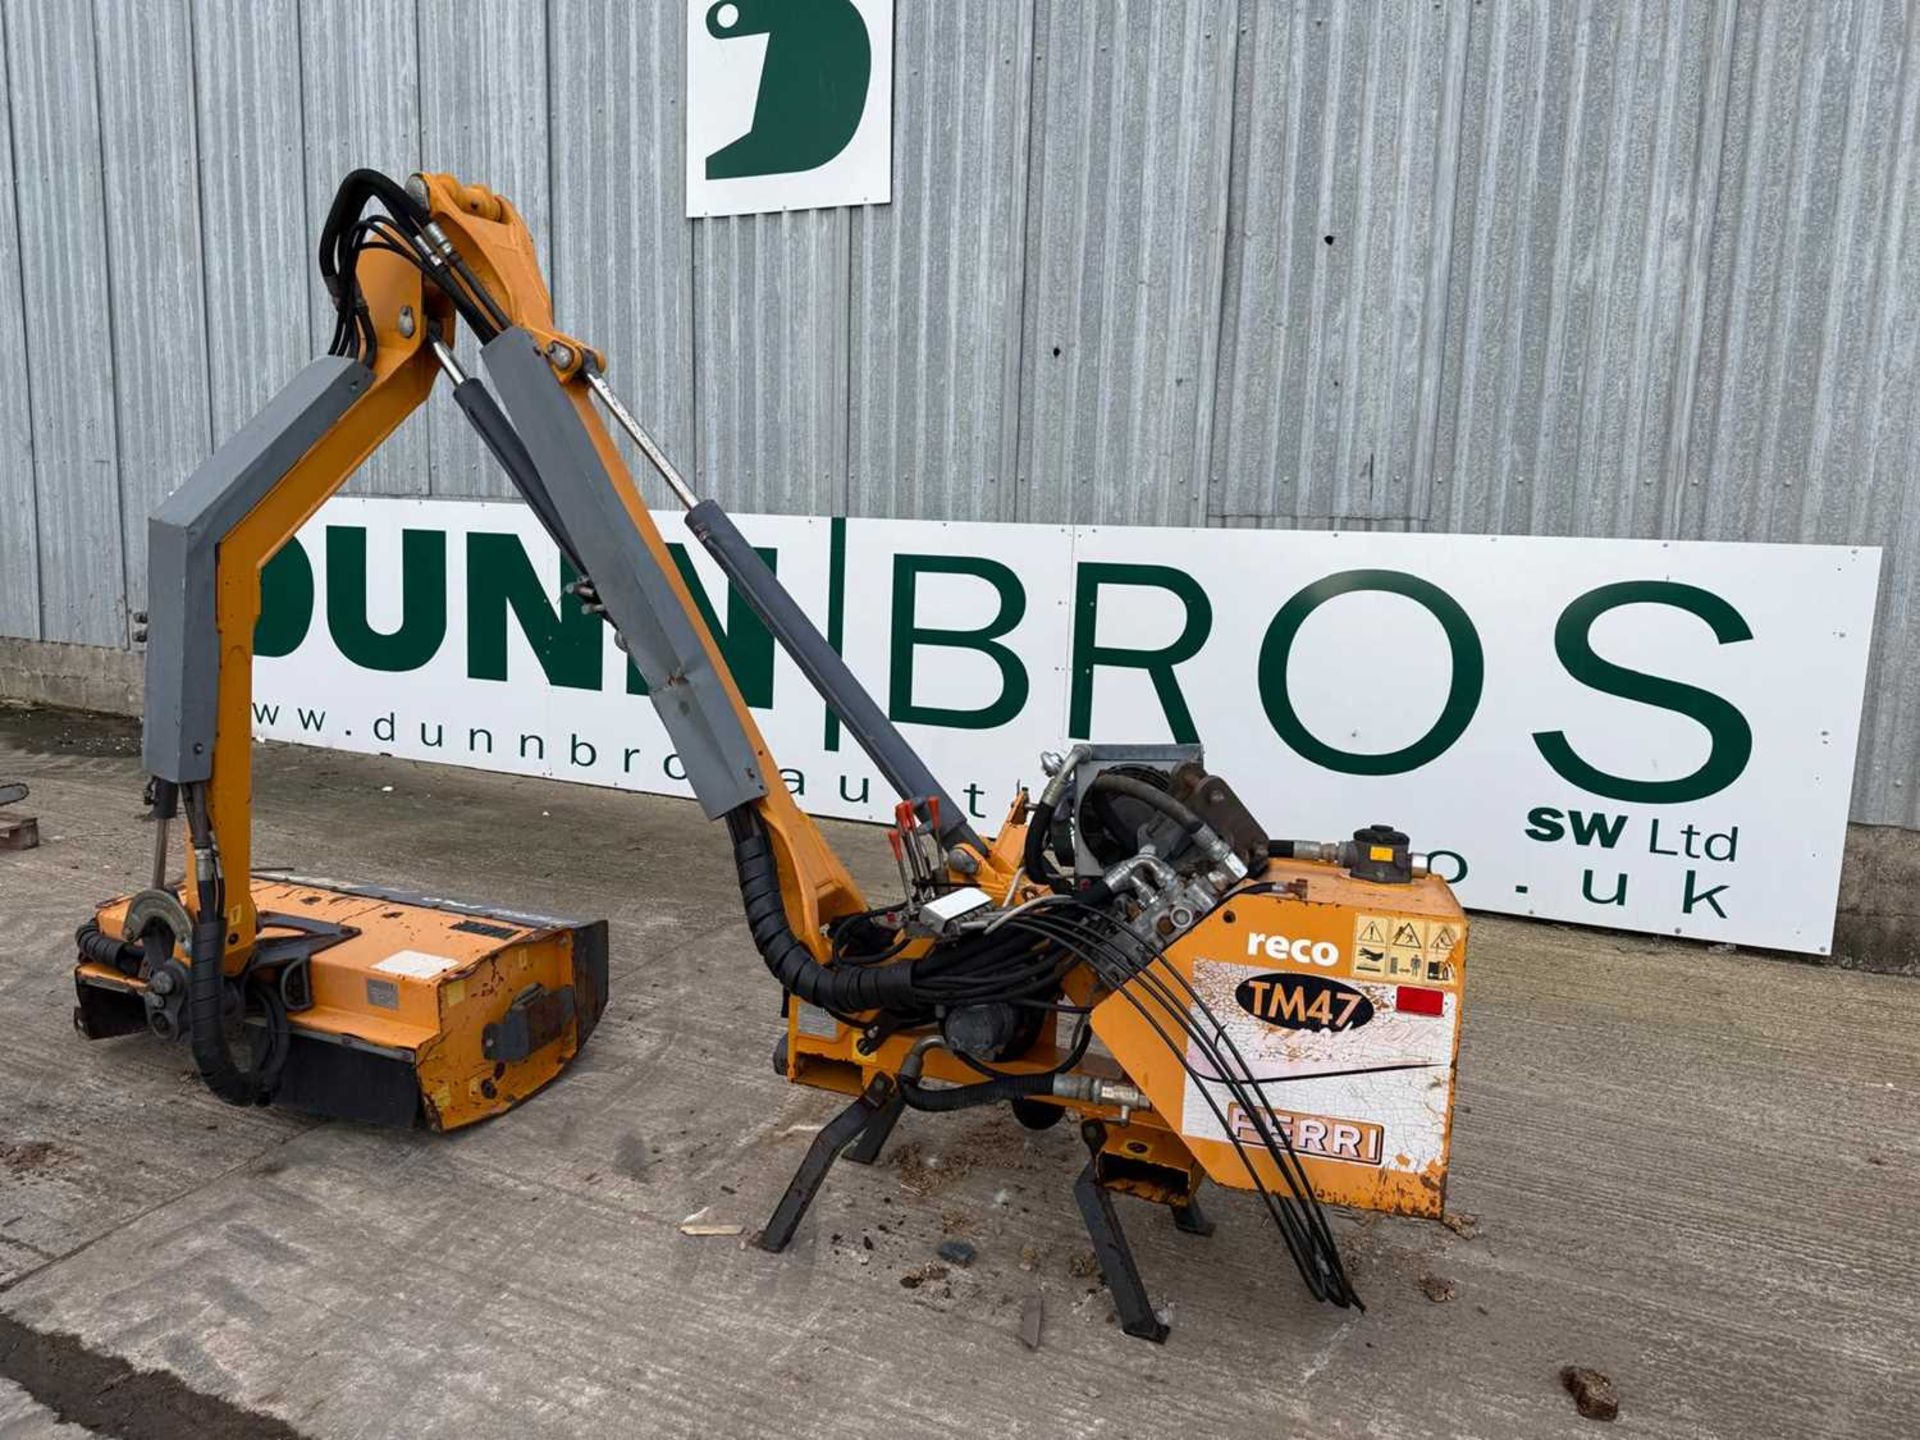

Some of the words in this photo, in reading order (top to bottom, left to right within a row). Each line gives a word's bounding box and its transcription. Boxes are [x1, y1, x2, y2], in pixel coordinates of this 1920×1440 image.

[889, 553, 1754, 804] BROS
[1649, 818, 1739, 862] Ltd
[1247, 932, 1339, 967] reco
[1249, 980, 1363, 1028] TM47
